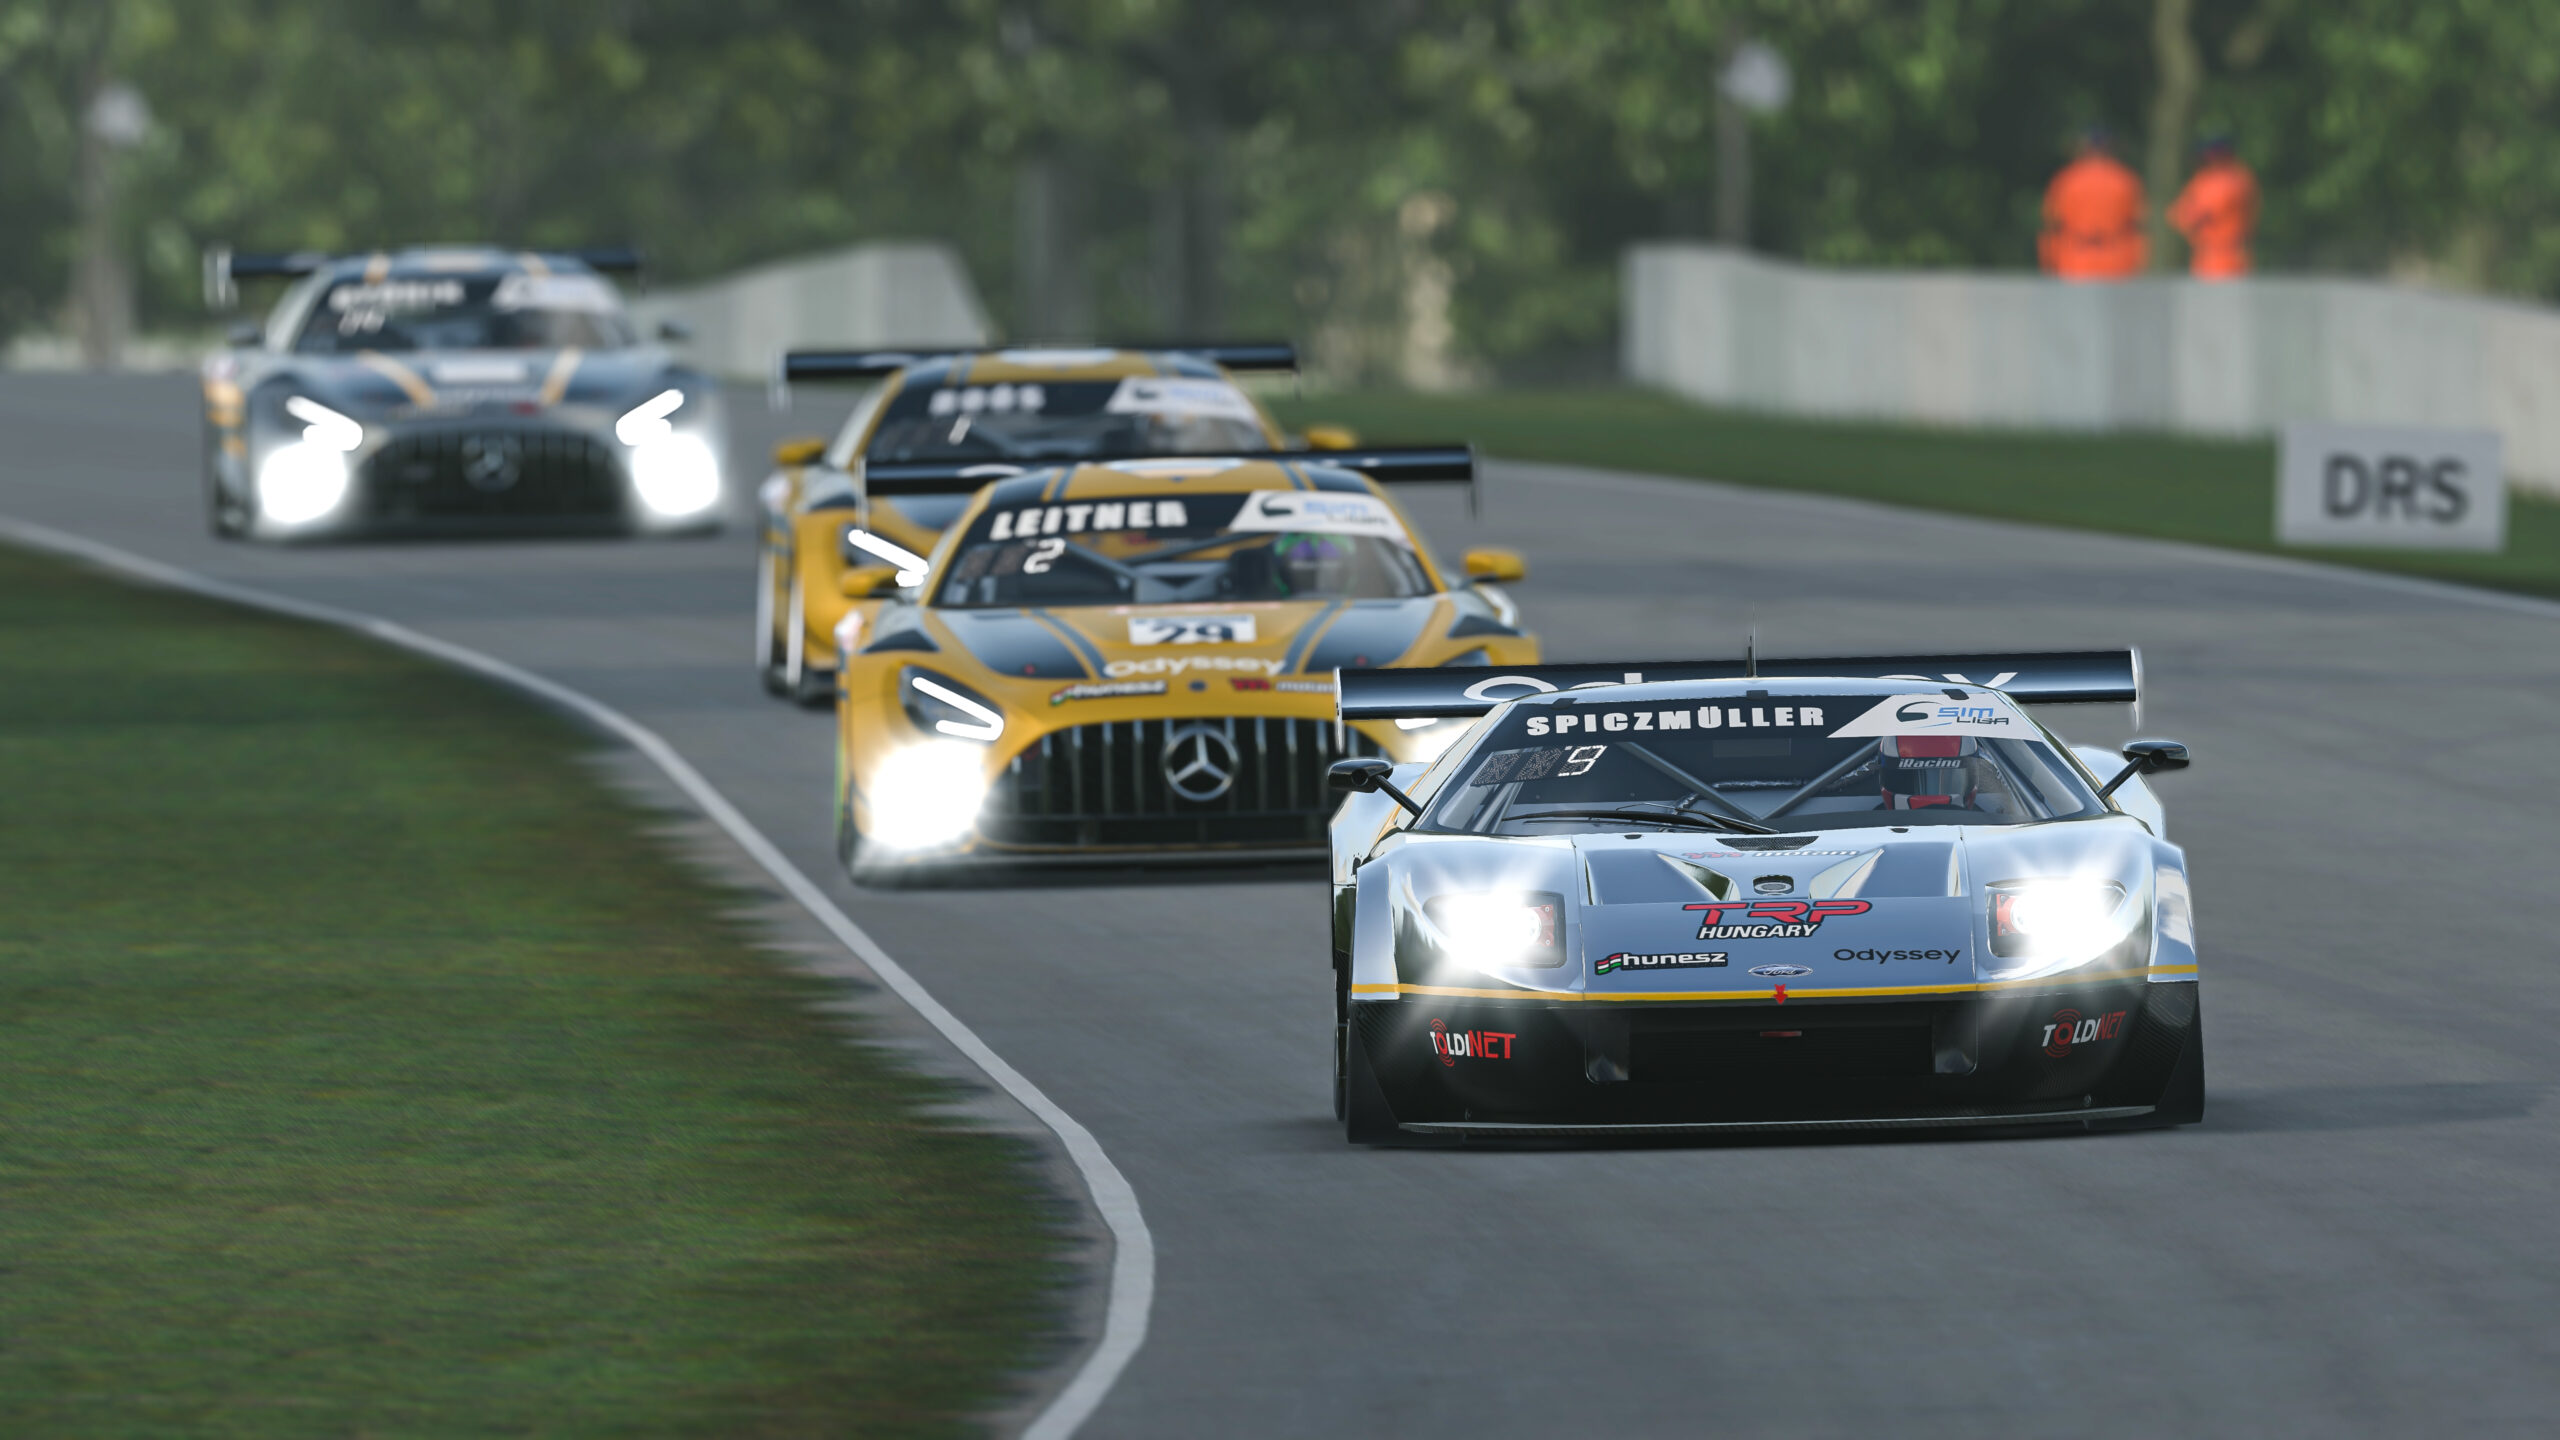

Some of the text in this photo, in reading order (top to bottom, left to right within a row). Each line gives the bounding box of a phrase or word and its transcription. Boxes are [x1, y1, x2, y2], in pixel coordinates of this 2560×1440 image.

[2324, 454, 2468, 526] DRS
[990, 499, 1188, 540] LEITNER
[1526, 706, 1824, 736] SPICZMÜLLER
[1898, 757, 1962, 769] iRacing
[1682, 900, 1872, 925] TRP
[1699, 924, 1818, 939] HUNGARY
[1623, 952, 1726, 966] hunesz
[1833, 949, 1961, 965] Odyssey
